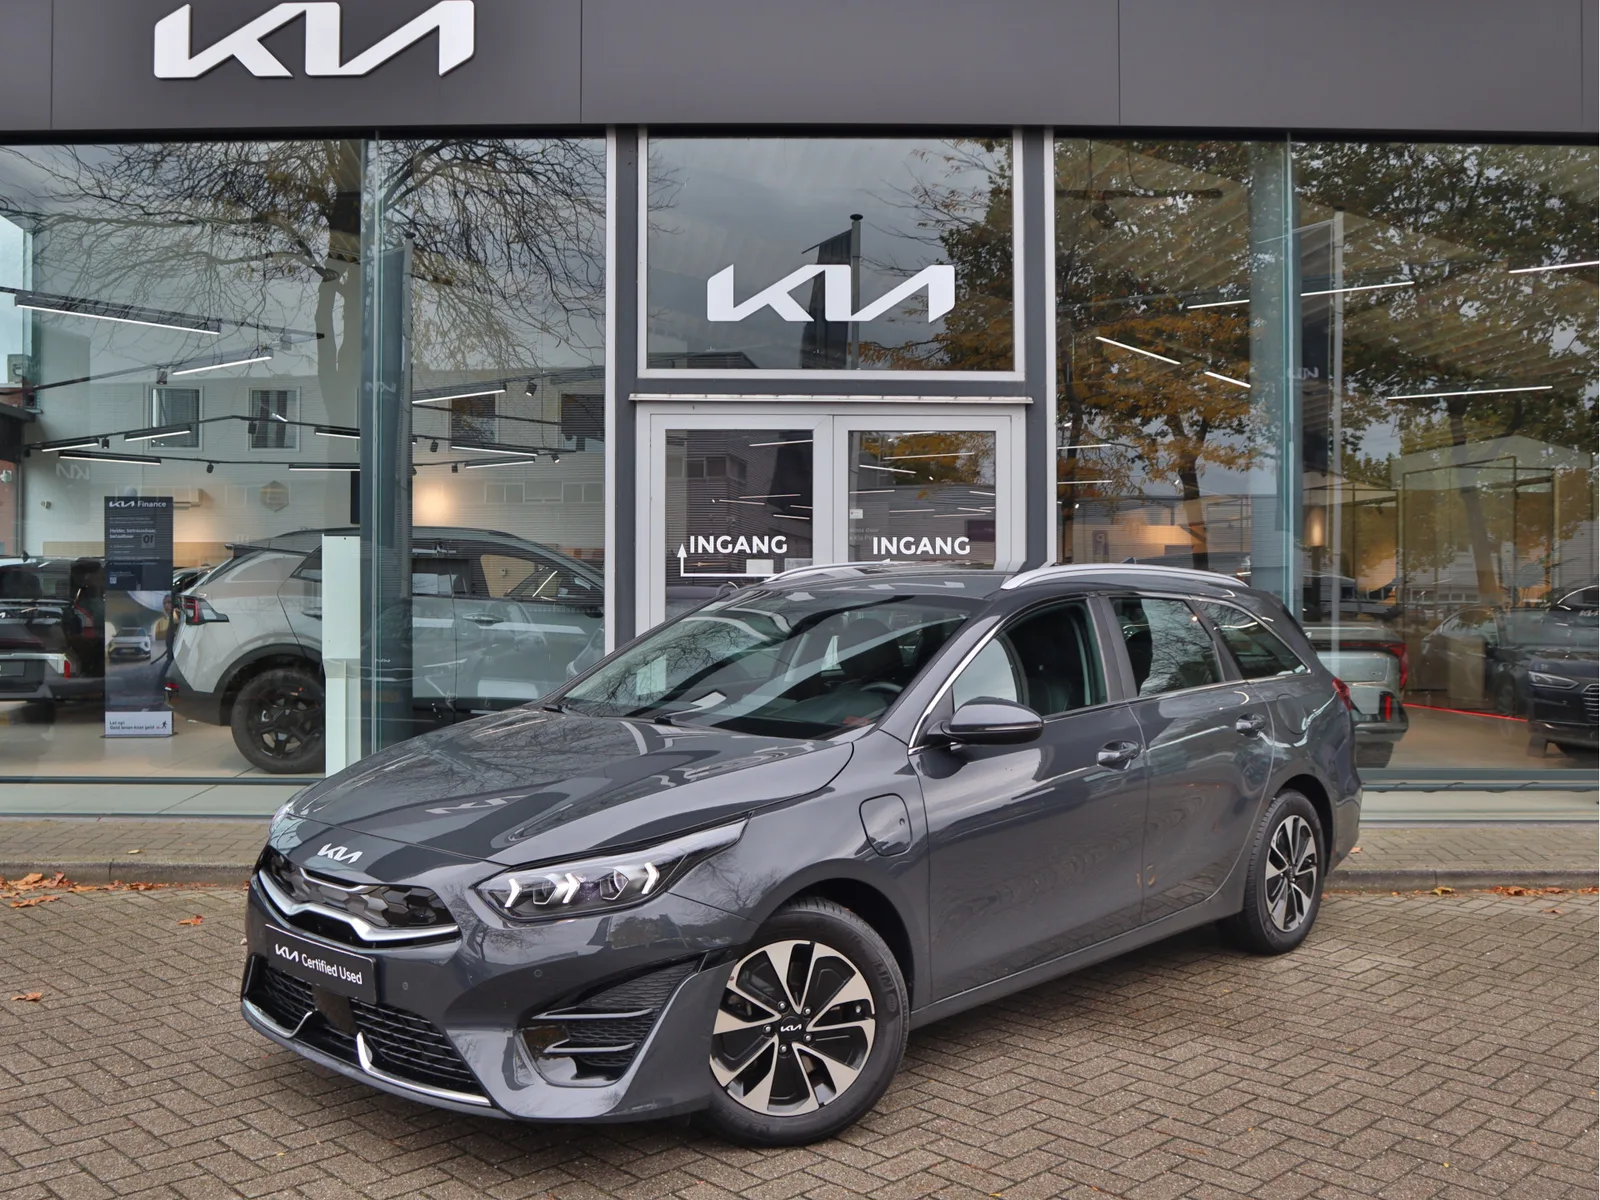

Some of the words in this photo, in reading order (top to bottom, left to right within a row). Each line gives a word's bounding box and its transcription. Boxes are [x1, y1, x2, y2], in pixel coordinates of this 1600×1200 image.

[154, 0, 475, 78] KIA
[707, 264, 955, 323] KIA
[689, 535, 788, 554] INGANG
[872, 536, 971, 555] INGANG
[317, 843, 363, 864] KIA
[275, 943, 299, 962] KIA
[301, 953, 338, 977] Certified
[339, 965, 363, 985] Used
[780, 1023, 802, 1032] KIA
